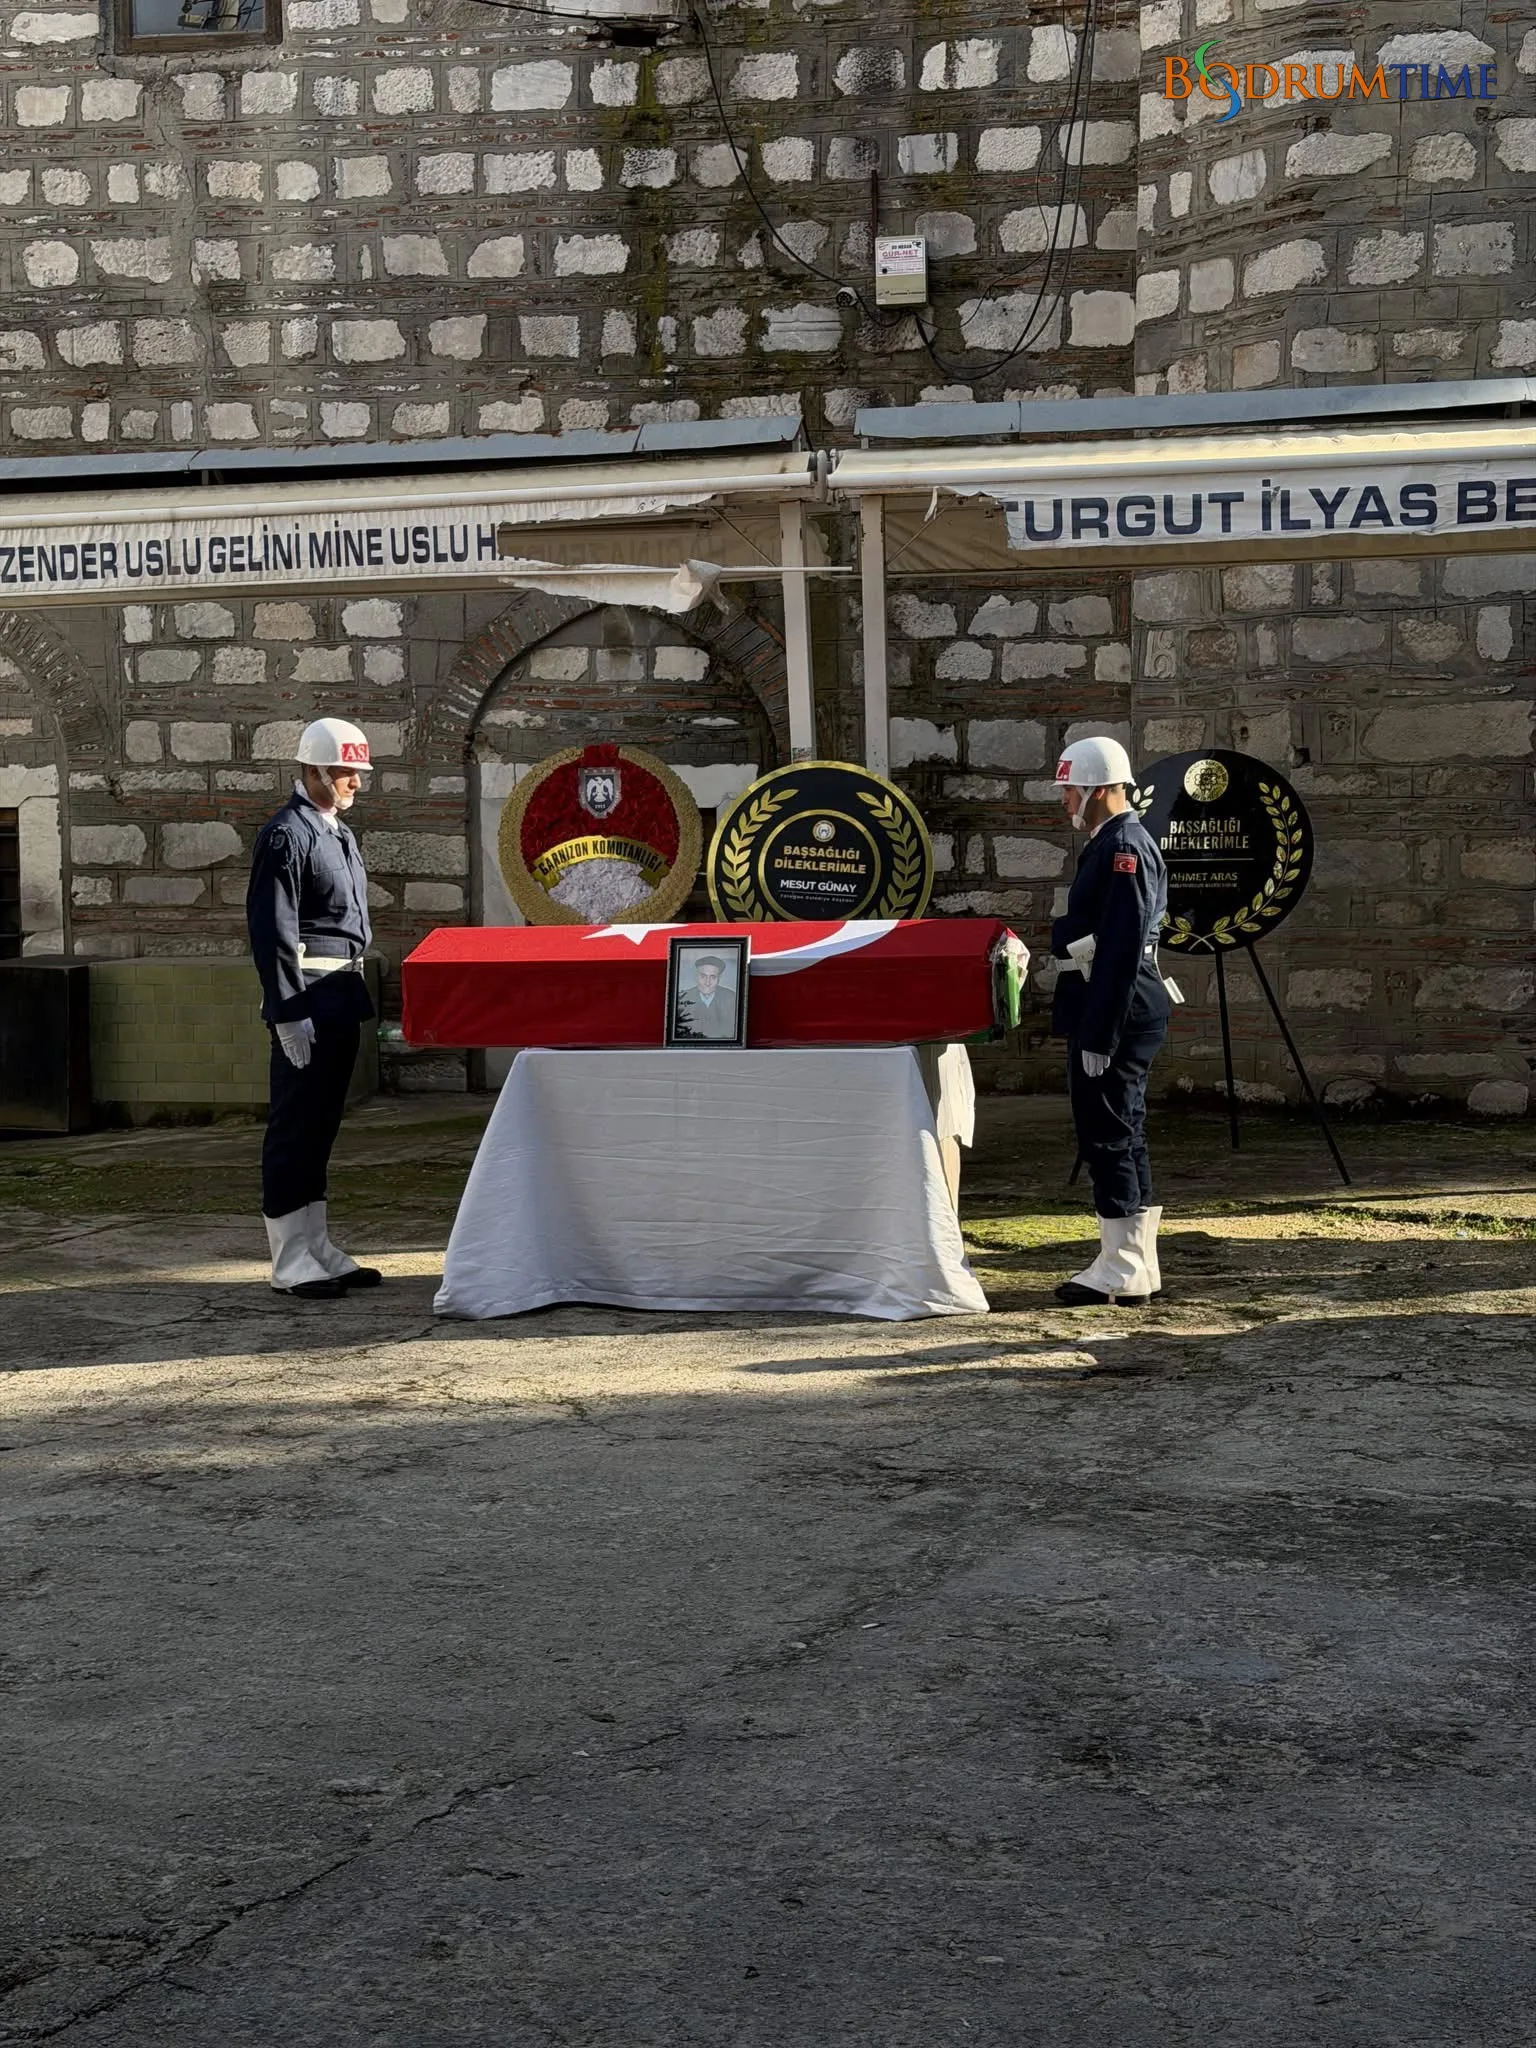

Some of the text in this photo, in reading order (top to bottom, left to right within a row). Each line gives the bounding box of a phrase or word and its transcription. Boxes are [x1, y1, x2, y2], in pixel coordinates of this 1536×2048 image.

[1261, 478, 1438, 530] İLYAS
[126, 537, 201, 578] USLU
[208, 523, 301, 573] GELİNİ
[308, 519, 383, 569] MİNE
[390, 524, 468, 564] USLU
[1160, 834, 1249, 851] DİLEKLERİMLE
[783, 845, 860, 860] BAŞSAĞLIĞI
[774, 857, 867, 874] DİLEKLERİMLE
[1170, 872, 1238, 881] AHMET ARAS
[780, 879, 857, 893] MESUT GÜNAY
